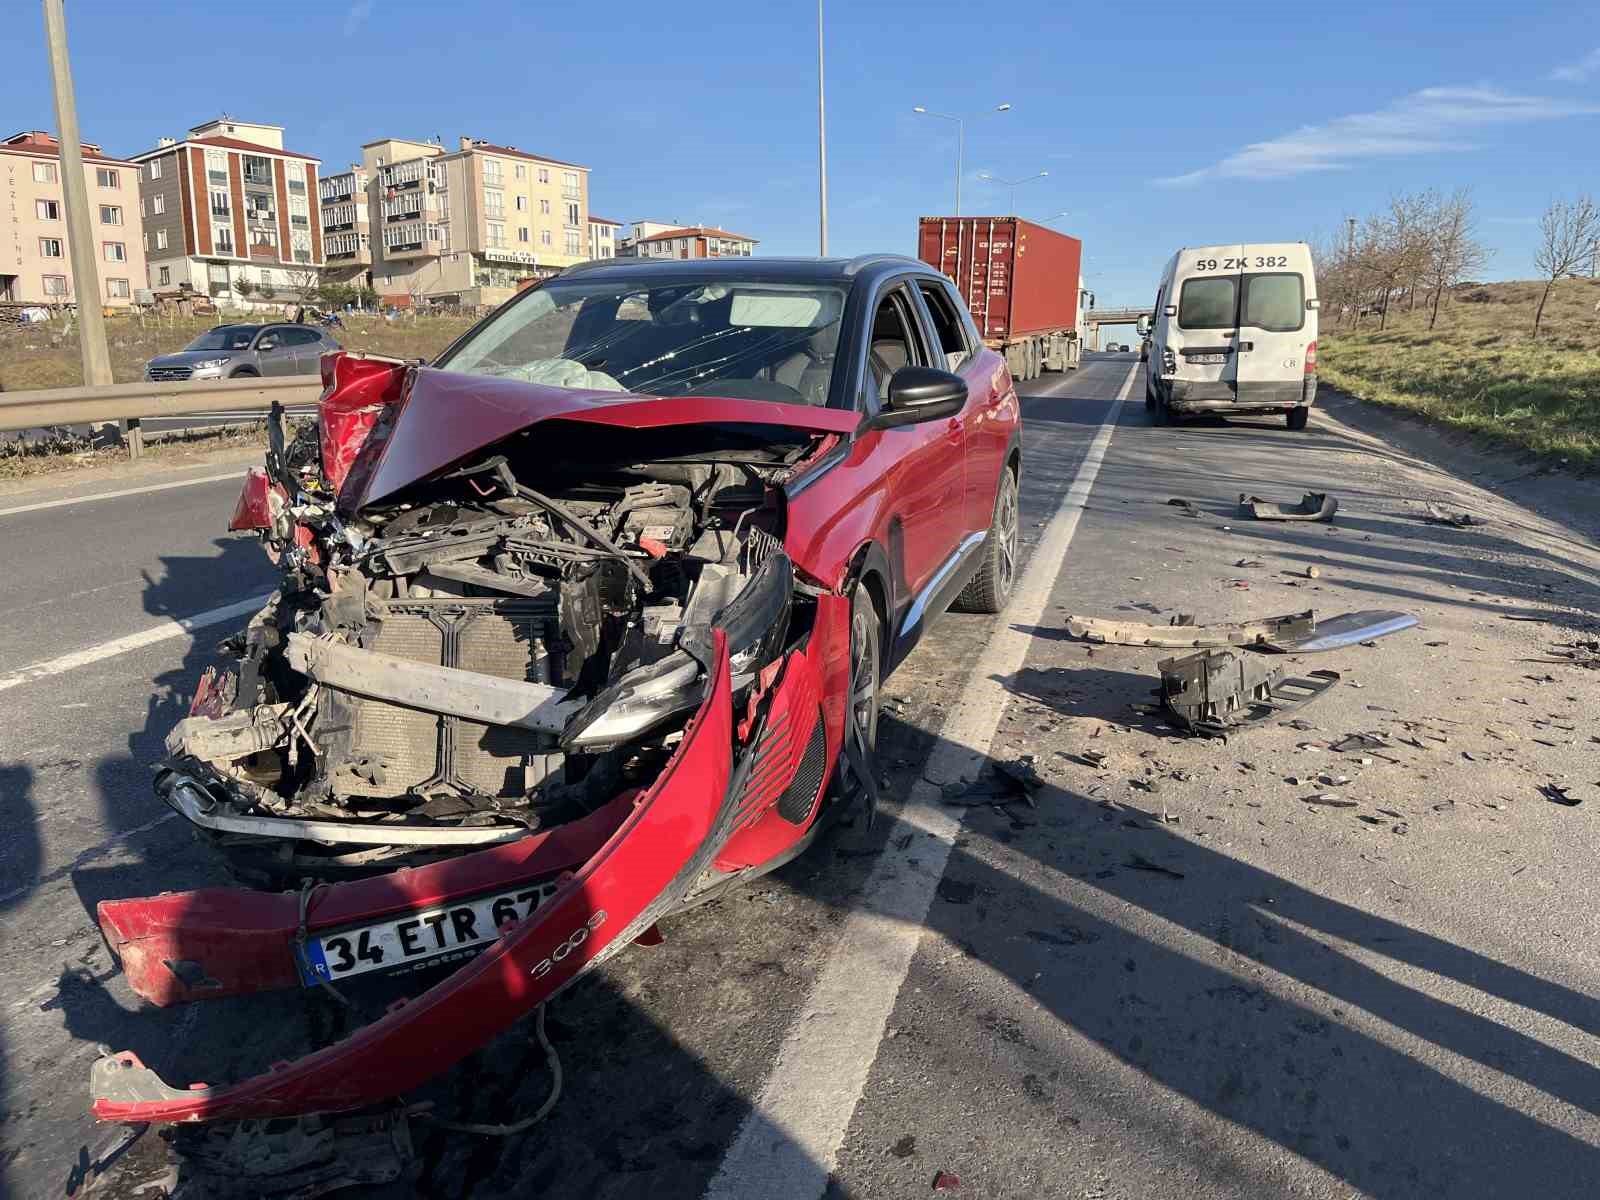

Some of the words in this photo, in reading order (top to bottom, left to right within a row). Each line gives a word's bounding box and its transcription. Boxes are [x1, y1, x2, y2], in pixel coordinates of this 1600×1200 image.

[1196, 259, 1217, 271] 59
[1223, 257, 1248, 269] ZK
[1255, 256, 1288, 268] 382
[325, 930, 384, 972] 34
[397, 907, 479, 956] ETR
[492, 885, 558, 928] 67
